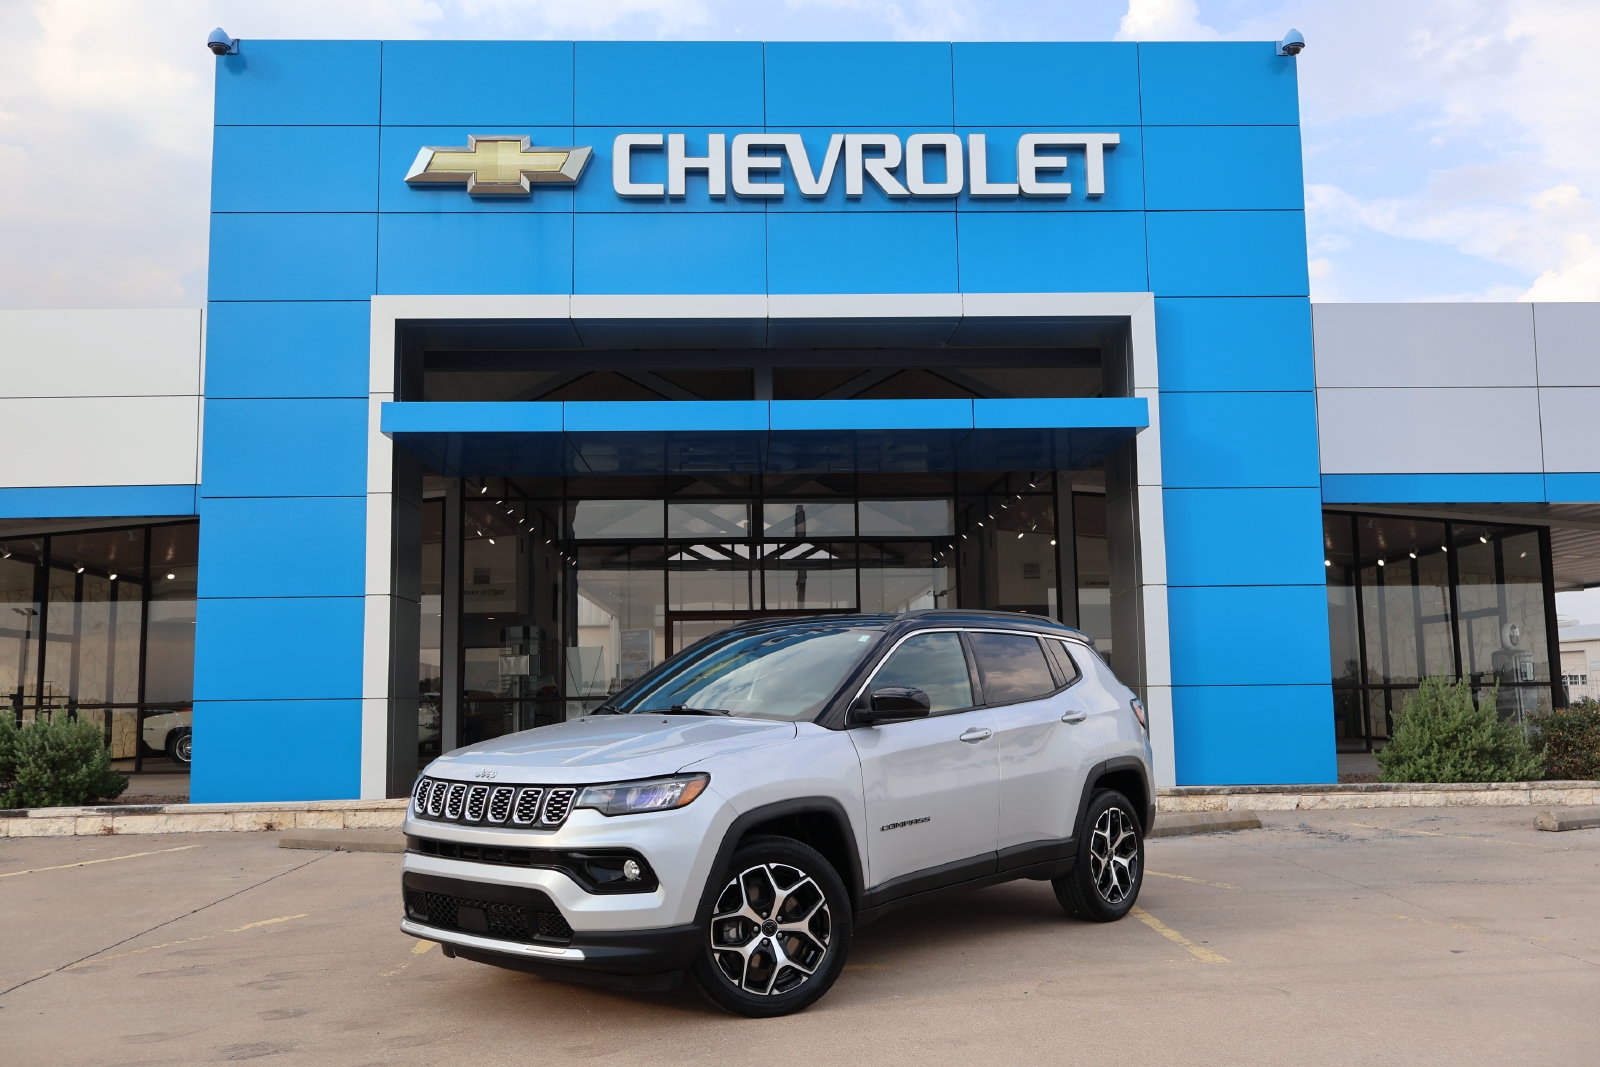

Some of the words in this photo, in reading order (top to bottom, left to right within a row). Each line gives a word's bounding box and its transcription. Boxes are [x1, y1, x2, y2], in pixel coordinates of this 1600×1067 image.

[612, 132, 1121, 199] CHEVROLET
[474, 767, 498, 779] Jeep
[880, 816, 931, 832] COMPASS
